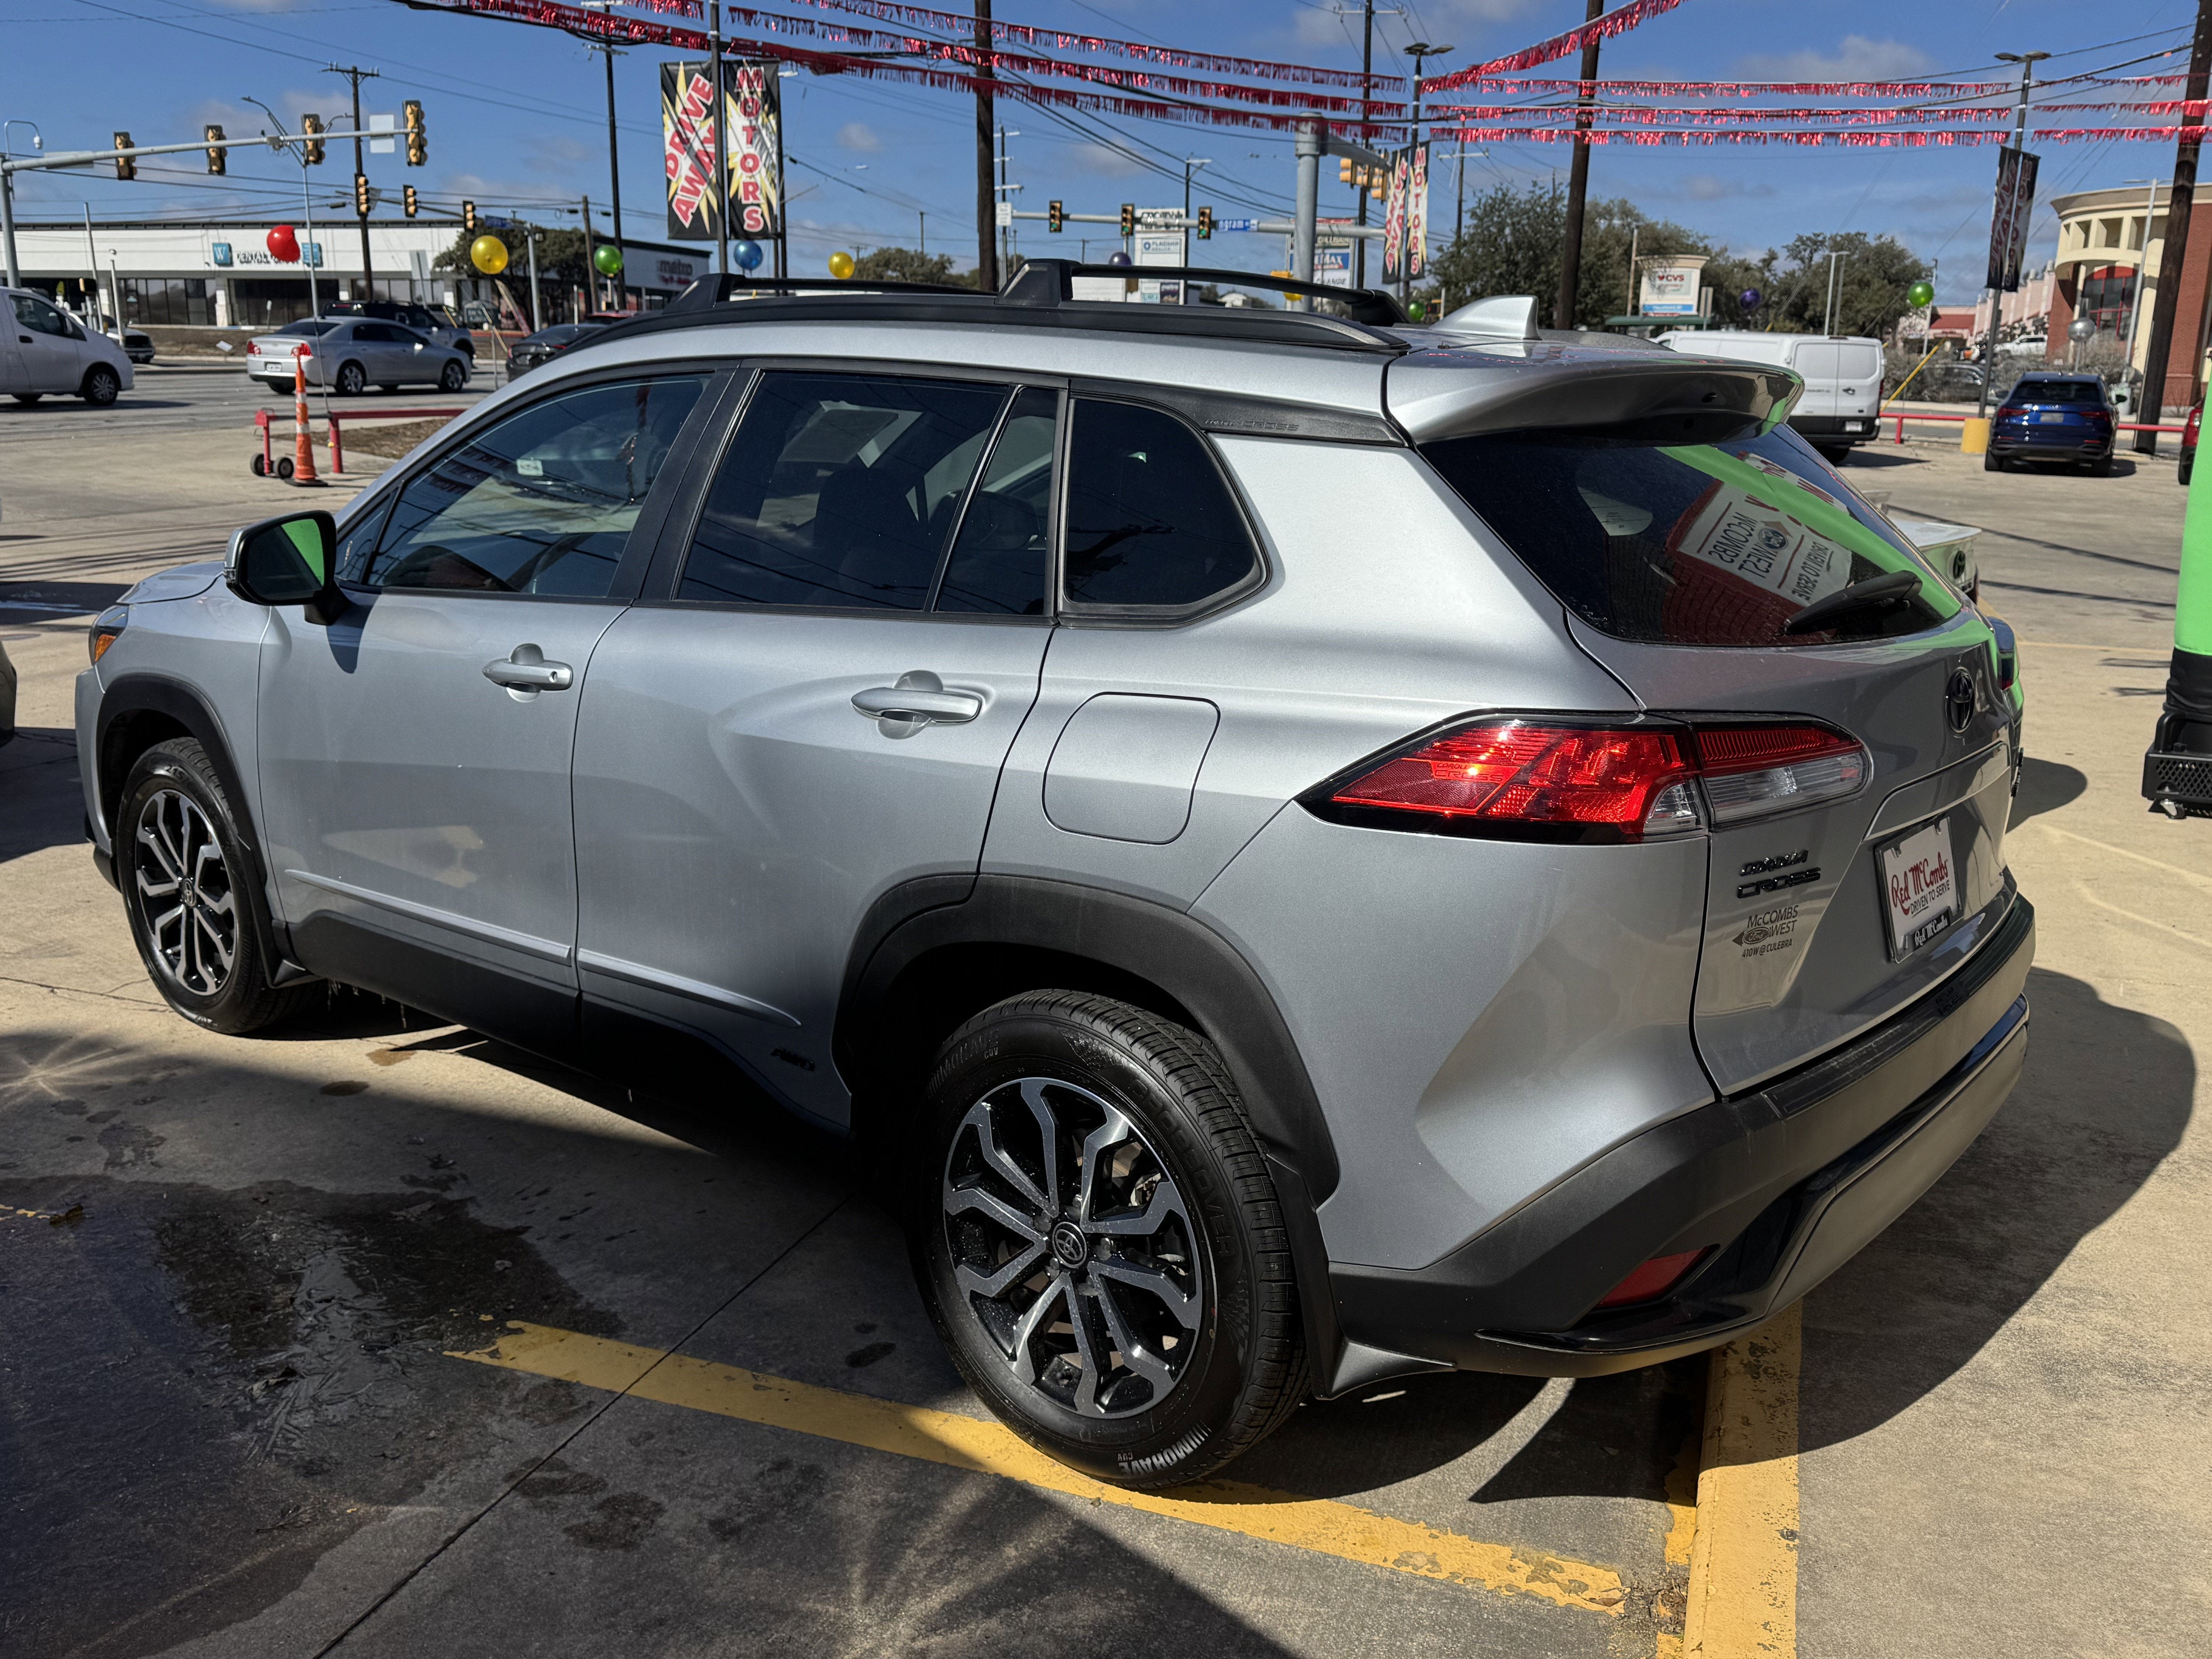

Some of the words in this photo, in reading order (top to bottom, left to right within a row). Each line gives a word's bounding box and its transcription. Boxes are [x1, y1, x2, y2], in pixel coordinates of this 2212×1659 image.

[666, 73, 714, 182] DRIVE
[735, 67, 766, 232] MOTORS
[1410, 147, 1426, 274] MOTORS
[1434, 769, 1503, 781] CROSS
[1737, 867, 1821, 899] CROSS
[1891, 870, 1911, 915] Red
[1908, 851, 1948, 896] McCombs
[1910, 893, 1928, 914] DRIVEN
[1928, 889, 1936, 902] TO
[1936, 879, 1950, 898] SERVE
[1747, 905, 1799, 929] McCOMBS
[1132, 1078, 1235, 1257] CROSSOVER
[1117, 1452, 1133, 1462] CUV
[1118, 1437, 1194, 1476] MOHAVE
